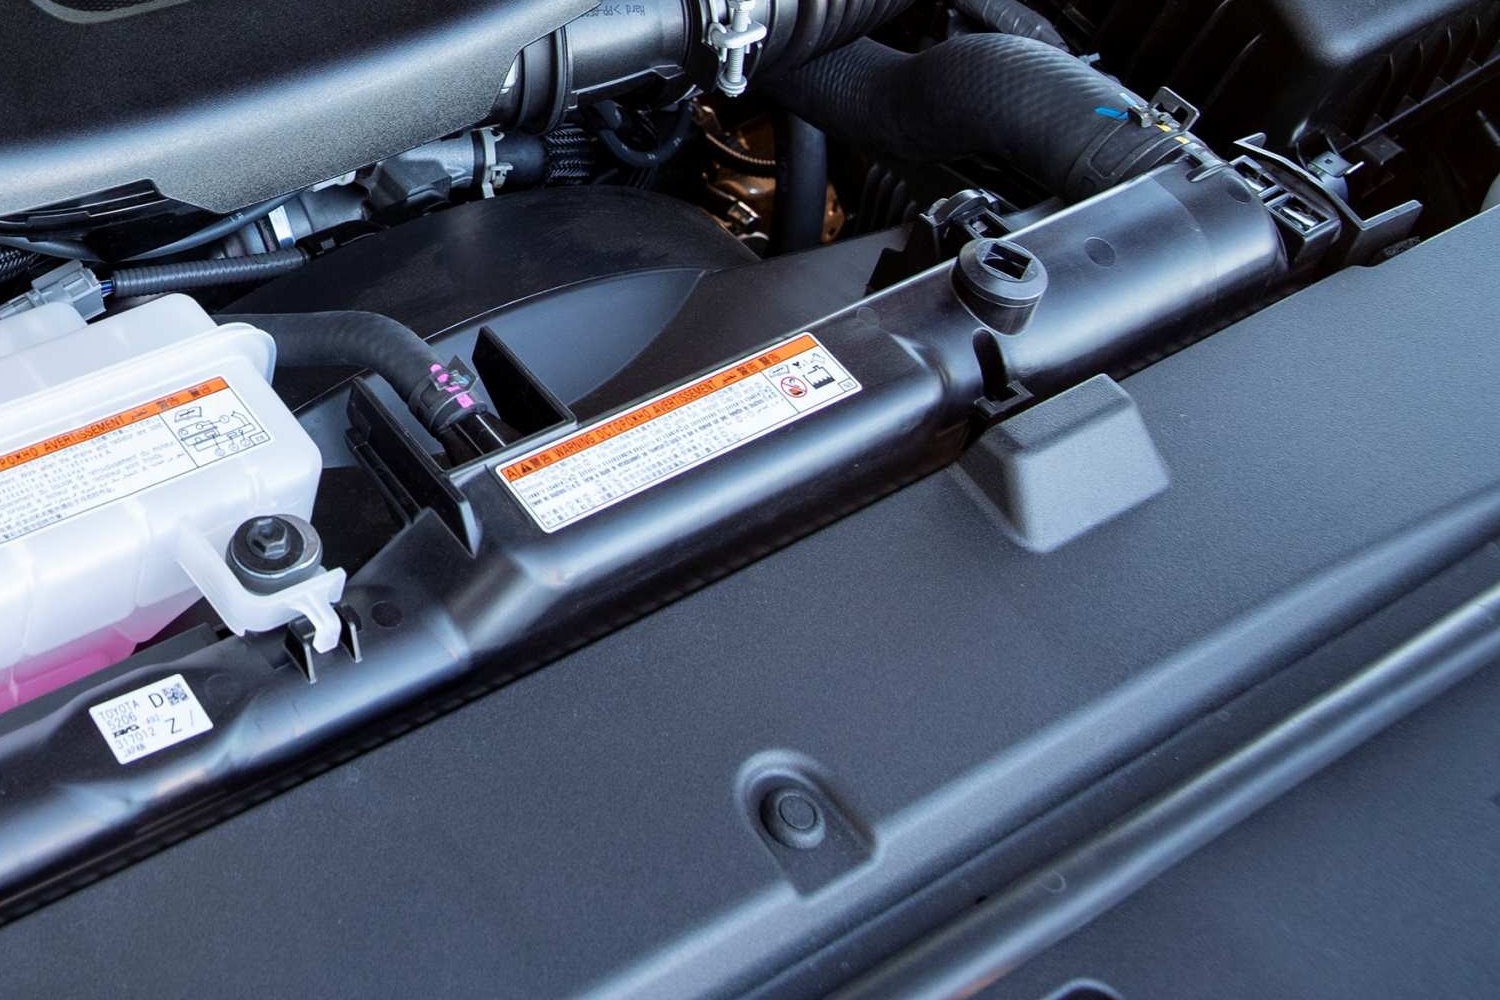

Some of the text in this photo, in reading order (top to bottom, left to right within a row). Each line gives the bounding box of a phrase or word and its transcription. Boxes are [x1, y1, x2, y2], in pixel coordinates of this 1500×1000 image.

[651, 378, 719, 414] AVERTISSEMENT
[43, 414, 126, 450] AVERTISSEMENT
[554, 433, 596, 458] WARNING
[505, 467, 517, 481] A
[98, 699, 140, 722] TOYOTA
[148, 692, 164, 709] D
[164, 717, 182, 735] Z
